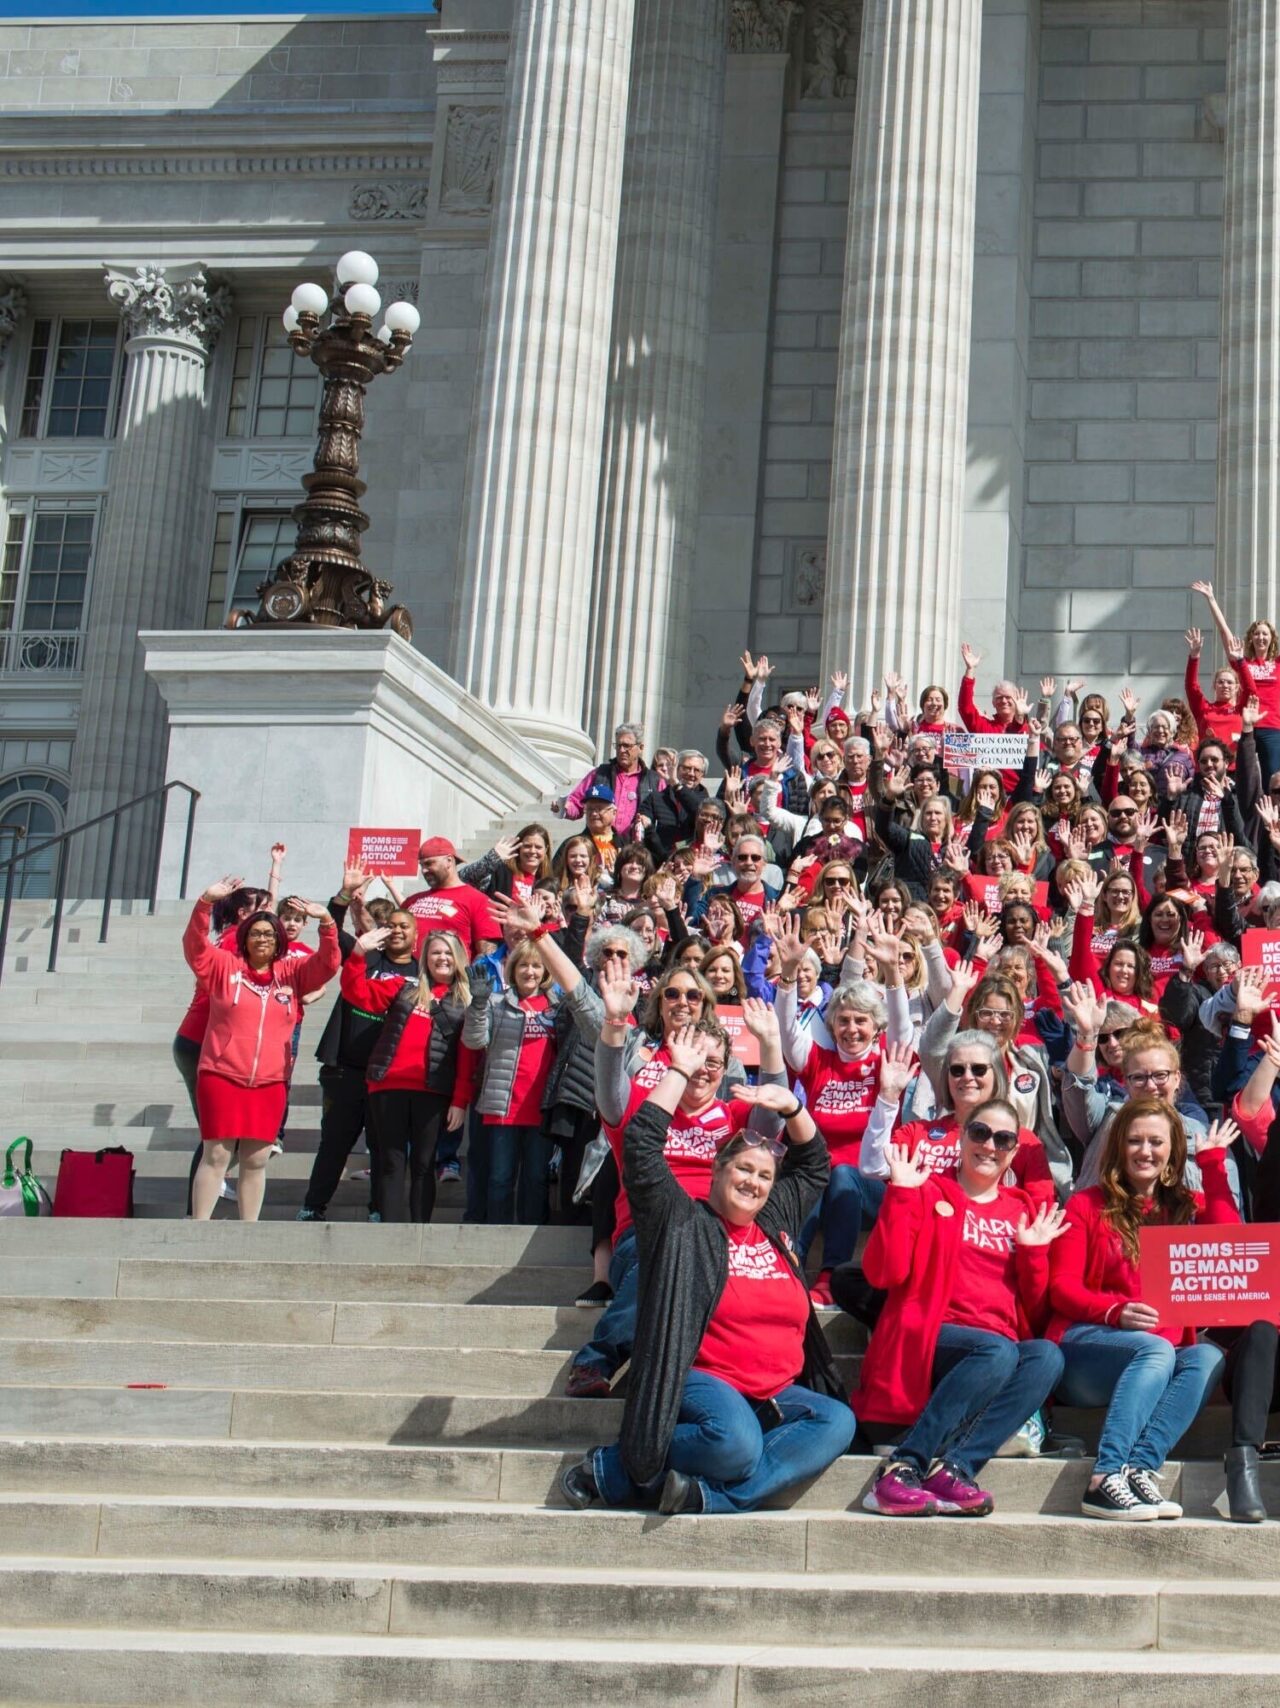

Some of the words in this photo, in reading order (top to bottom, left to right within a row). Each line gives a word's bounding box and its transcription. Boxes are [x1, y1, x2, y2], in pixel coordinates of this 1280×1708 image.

[362, 836, 391, 845] MOMS
[361, 844, 402, 852] DEMAND
[361, 852, 397, 860] ACTION
[524, 1025, 546, 1033] TION
[919, 1140, 961, 1157] MOM
[963, 1222, 1017, 1253] HATE
[1169, 1243, 1233, 1258] MOMS
[1169, 1258, 1259, 1275] DEMAND
[1170, 1275, 1248, 1291] ACTION
[1171, 1294, 1186, 1303] FOR
[1187, 1294, 1202, 1302] GUN
[1203, 1293, 1227, 1301] SENSE
[1228, 1292, 1235, 1300] IN
[1237, 1291, 1270, 1301] AMERICA
